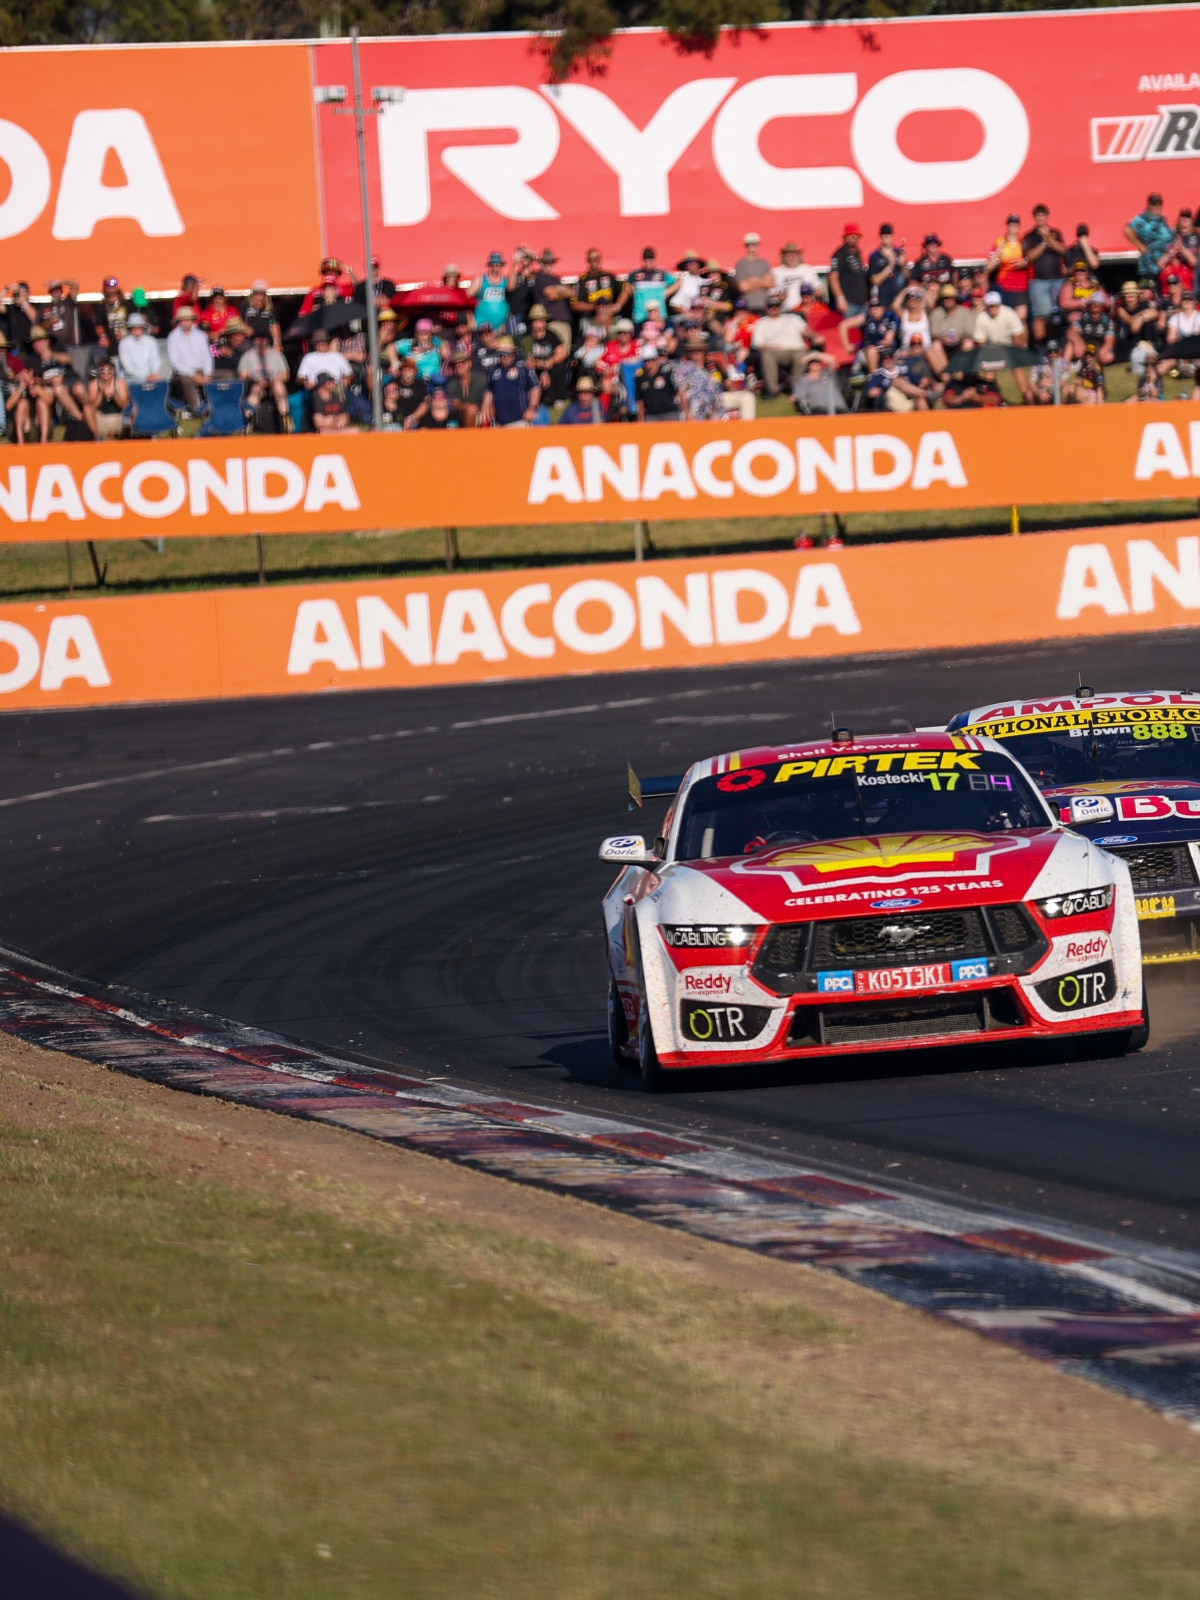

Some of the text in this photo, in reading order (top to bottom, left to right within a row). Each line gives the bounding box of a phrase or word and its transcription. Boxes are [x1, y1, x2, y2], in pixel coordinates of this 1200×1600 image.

[378, 69, 1029, 225] RYCO
[529, 432, 967, 502] ANACONDA
[288, 564, 860, 673] ANACONDA
[1069, 724, 1188, 740] Brown 888
[778, 742, 919, 760] Shell V-Power
[773, 752, 983, 783] PIRTEK
[857, 772, 960, 791] Kostecki 17
[1081, 807, 1109, 815] Doric
[605, 848, 639, 856] Doric
[784, 879, 1004, 907] CELEBRATING 125 YEARS
[673, 931, 727, 946] CABLING
[1066, 937, 1108, 958] Reddy
[685, 973, 732, 993] Reddy
[1058, 971, 1107, 1007] OTR
[689, 1007, 747, 1039] OTR
